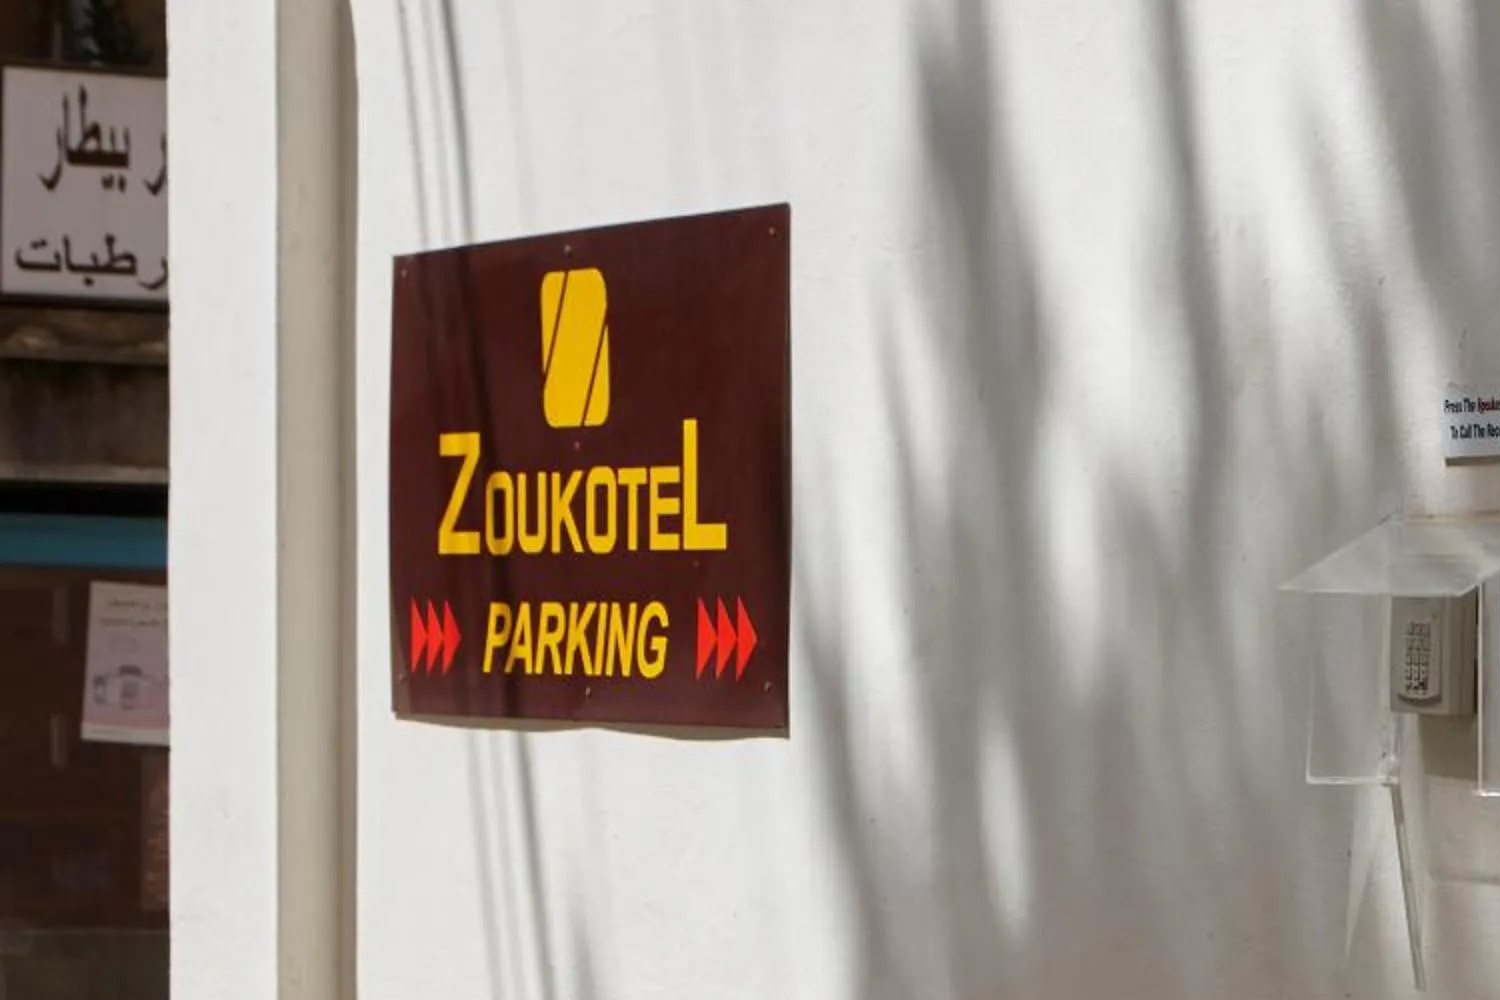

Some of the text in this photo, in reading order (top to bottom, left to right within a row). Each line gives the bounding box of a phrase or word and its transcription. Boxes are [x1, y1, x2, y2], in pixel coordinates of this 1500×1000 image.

[15, 232, 167, 290] رطبات
[1443, 399, 1462, 413] Press
[1463, 397, 1476, 412] The
[1450, 424, 1459, 439] To
[1460, 424, 1472, 438] Call
[1473, 423, 1485, 438] The
[438, 418, 728, 556] ZOUKOTEL
[483, 599, 670, 680] PARKING
